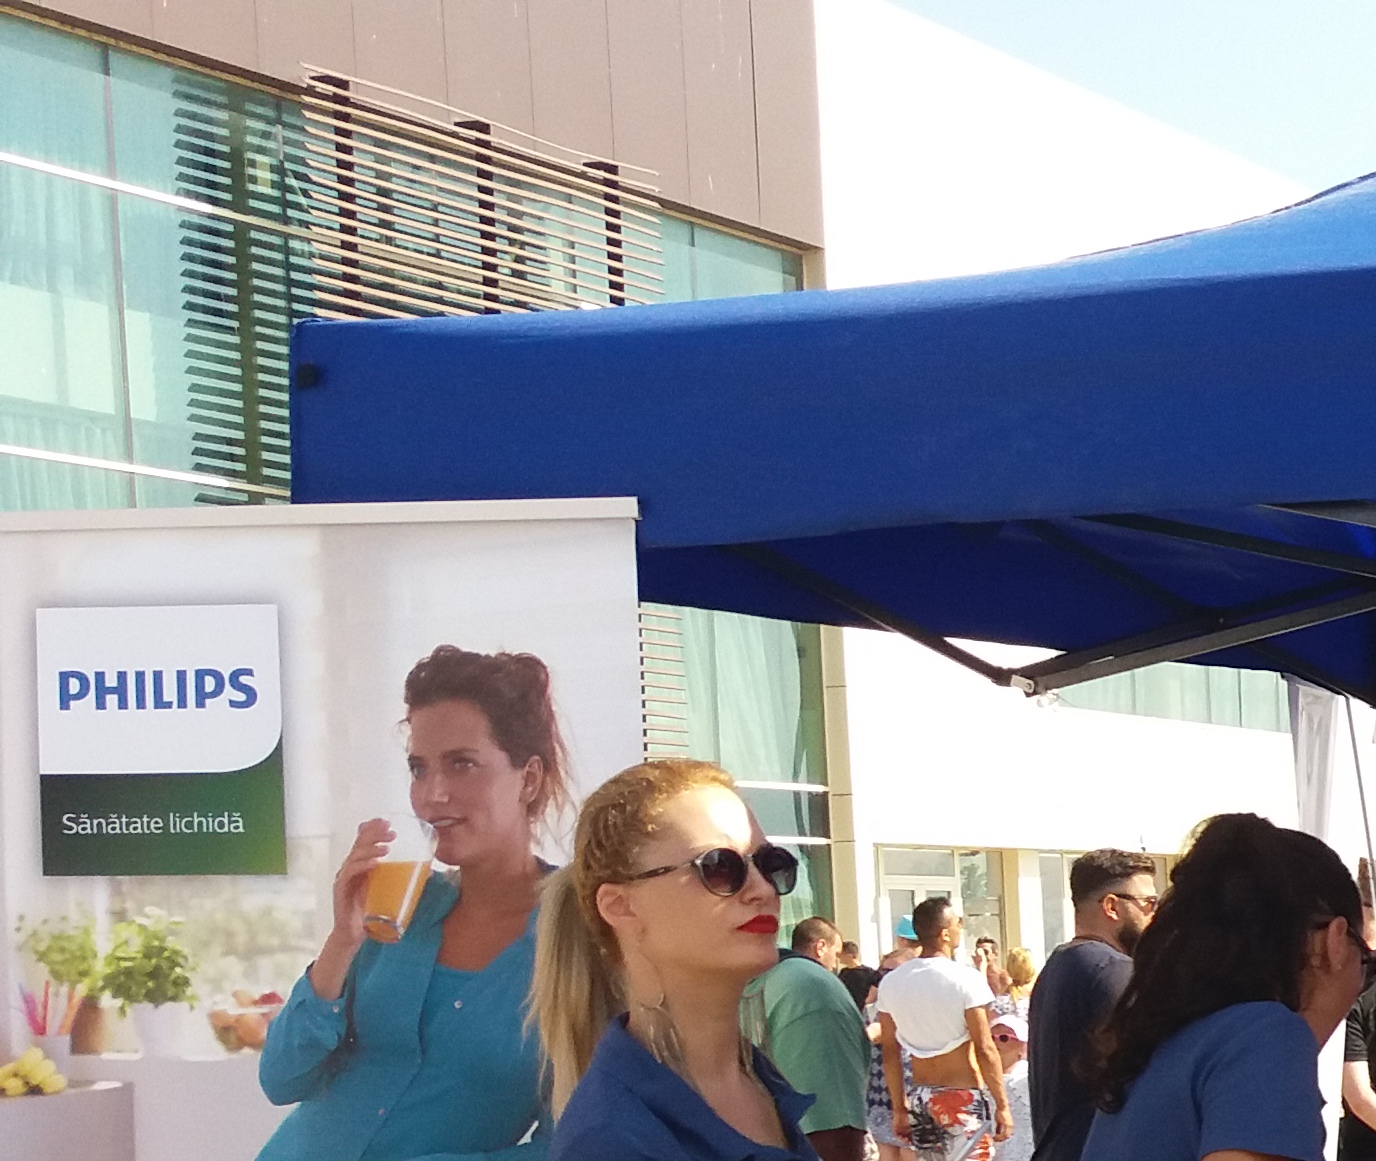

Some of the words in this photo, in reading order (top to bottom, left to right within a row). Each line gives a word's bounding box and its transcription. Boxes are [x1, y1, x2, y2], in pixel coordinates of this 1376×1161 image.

[57, 667, 259, 712] PHILIPS
[61, 811, 165, 836] Sănătate
[168, 809, 246, 835] lichidă
